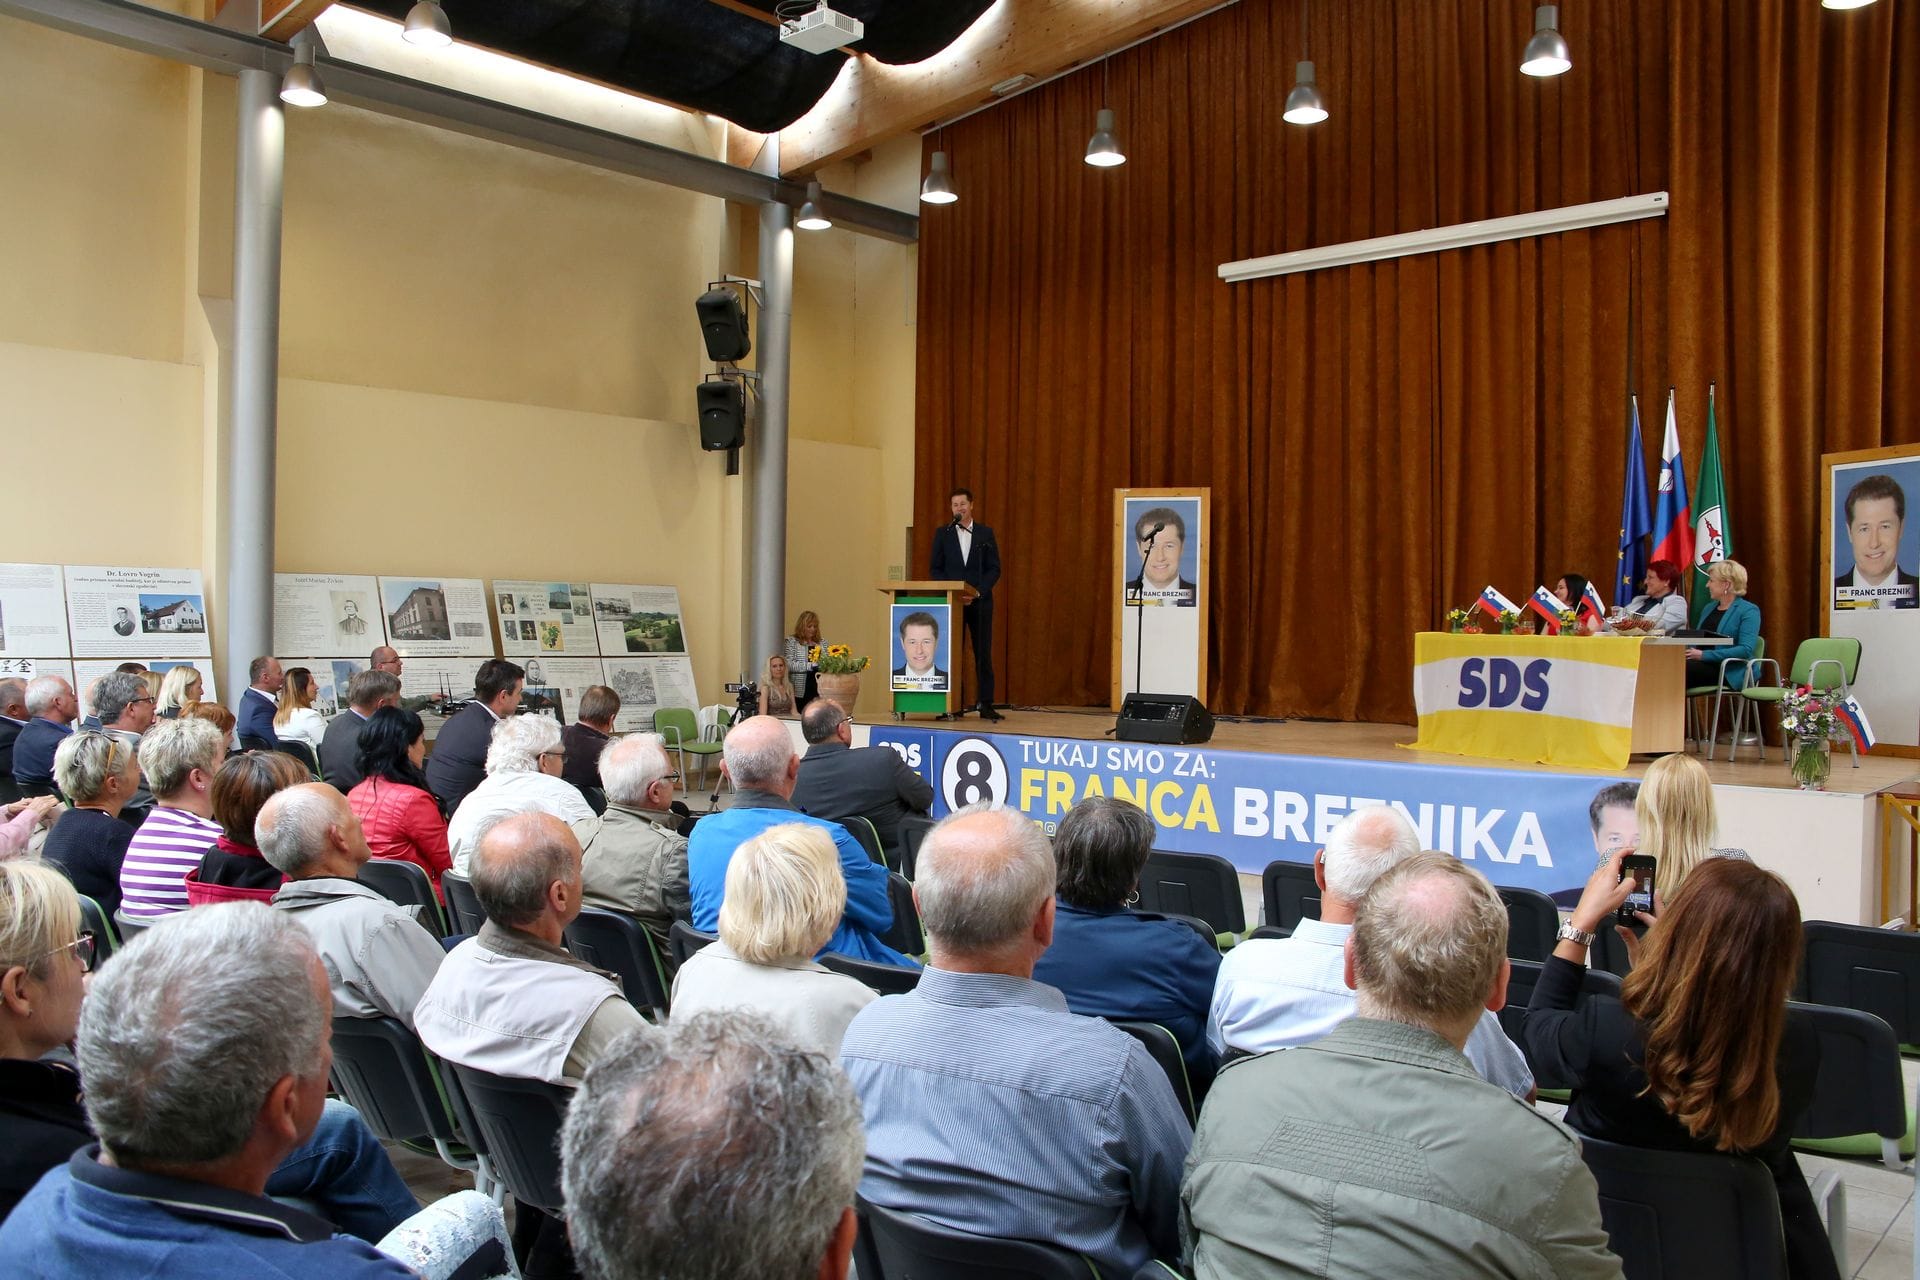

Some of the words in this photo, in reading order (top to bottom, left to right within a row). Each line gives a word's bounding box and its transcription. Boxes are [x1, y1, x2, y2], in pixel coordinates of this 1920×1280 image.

[1850, 589, 1875, 597] FRANC
[1877, 587, 1911, 596] BREZNIK
[1458, 657, 1552, 712] SDS
[878, 741, 922, 768] DS
[1019, 740, 1098, 769] TUKAJ
[1106, 747, 1165, 774] SMO
[1173, 752, 1216, 779] ZA:
[954, 750, 994, 810] 8
[1233, 787, 1553, 868] BRENIKA
